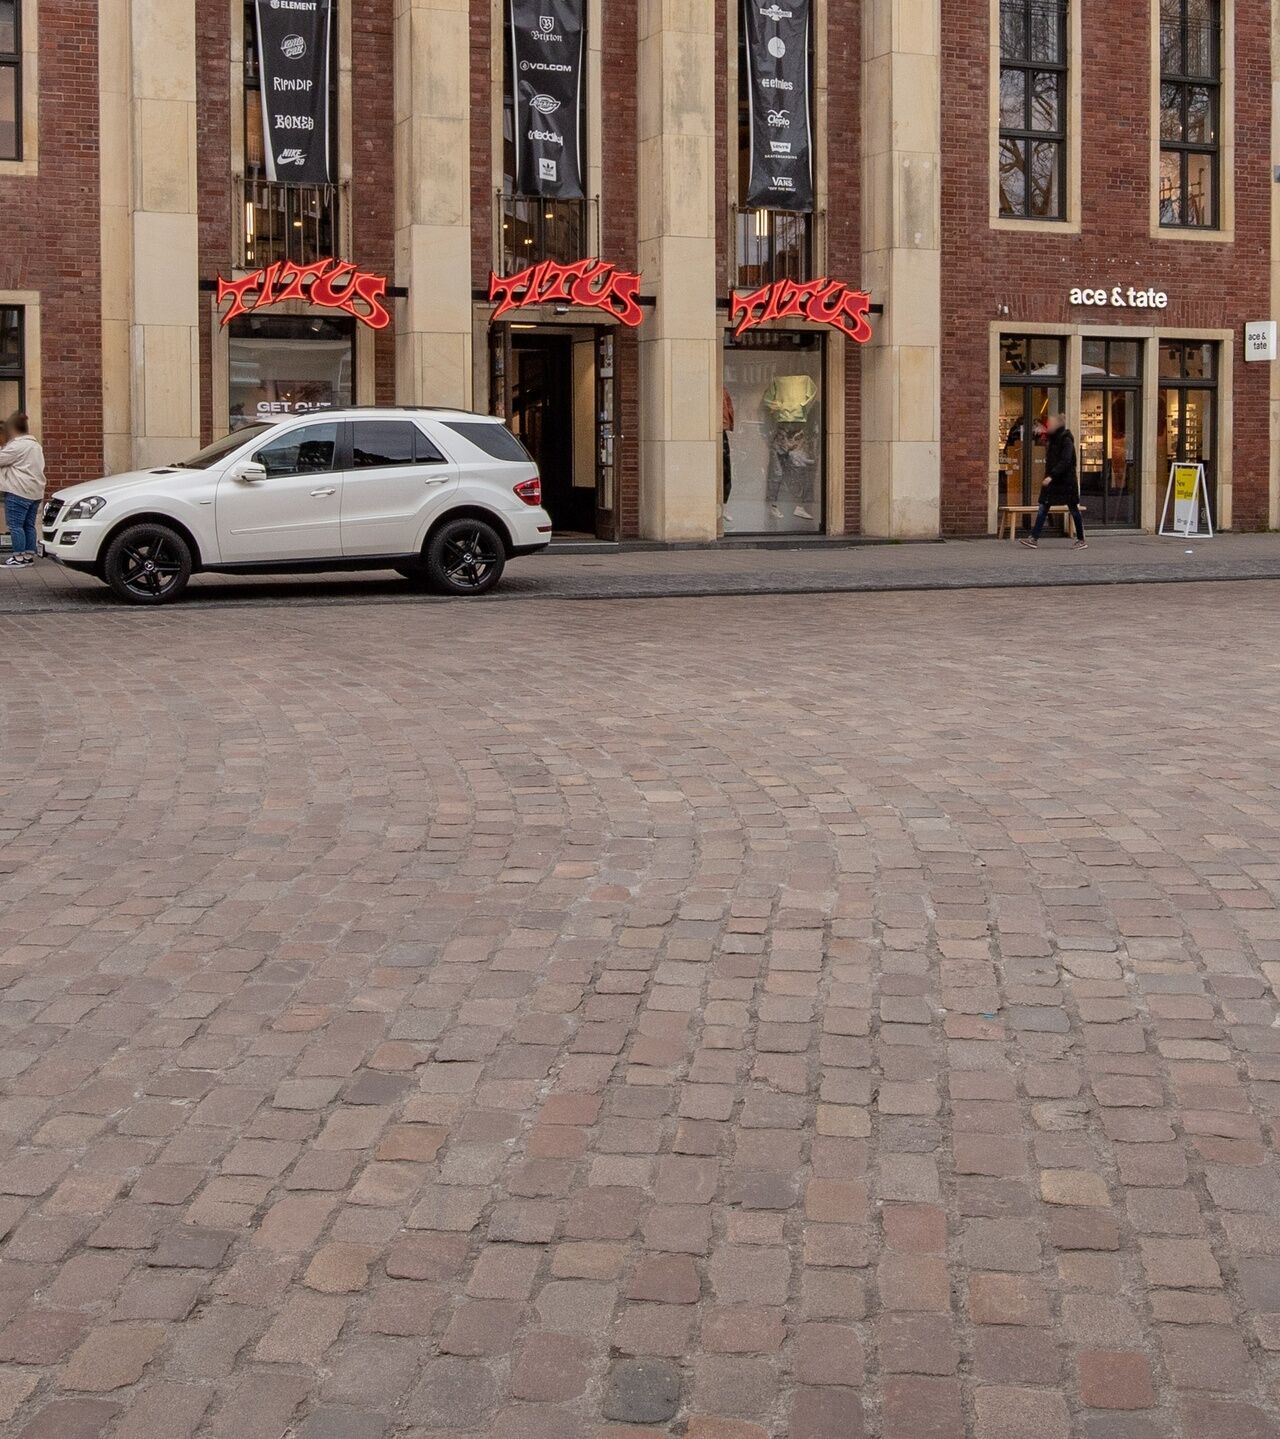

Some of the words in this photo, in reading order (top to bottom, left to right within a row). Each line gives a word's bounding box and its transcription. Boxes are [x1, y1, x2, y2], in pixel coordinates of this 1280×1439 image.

[280, 0, 317, 11] ELEMENT
[531, 30, 562, 42] Brixton
[529, 63, 572, 72] VOLCOM
[274, 114, 314, 131] BONES
[282, 148, 302, 158] NIKE
[294, 158, 306, 166] SB
[771, 176, 793, 187] VANS
[217, 257, 391, 332] TITUS
[490, 257, 645, 328] TITUS
[1069, 288, 1107, 306] ace
[1110, 287, 1127, 306] &
[1127, 287, 1168, 308] tate
[731, 276, 873, 344] TITUS
[1253, 341, 1267, 350] tate
[257, 401, 292, 412] GET
